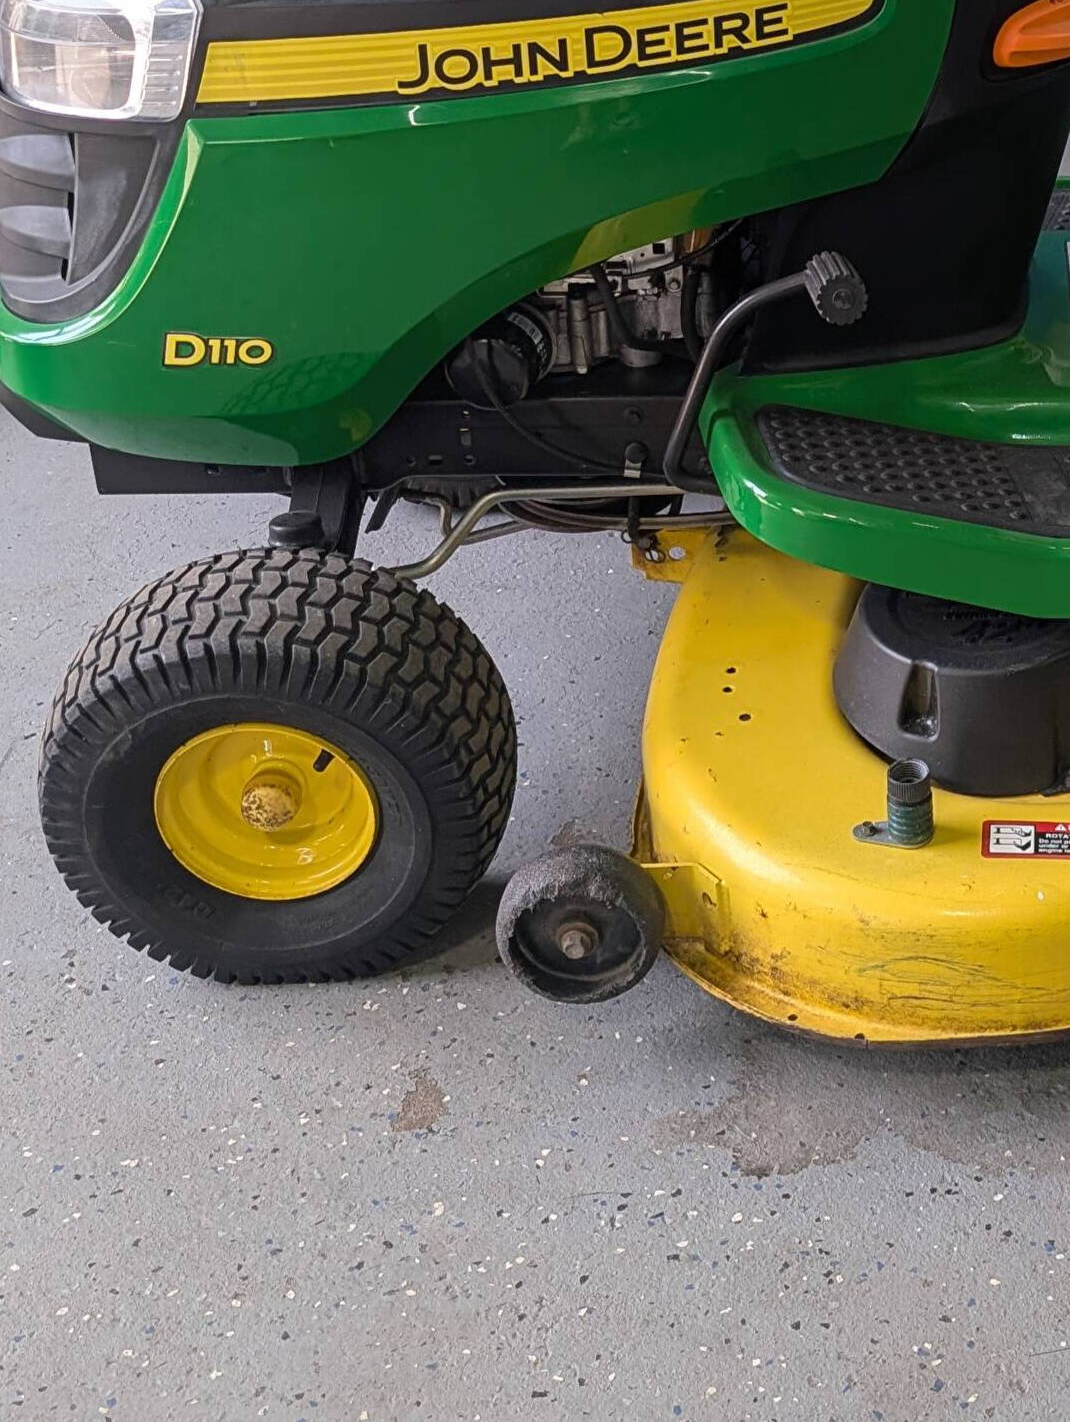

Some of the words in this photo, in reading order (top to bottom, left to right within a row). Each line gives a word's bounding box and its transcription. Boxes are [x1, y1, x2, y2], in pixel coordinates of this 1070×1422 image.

[398, 38, 569, 90] JOHN
[586, 4, 790, 70] DEERE
[165, 333, 273, 369] D110
